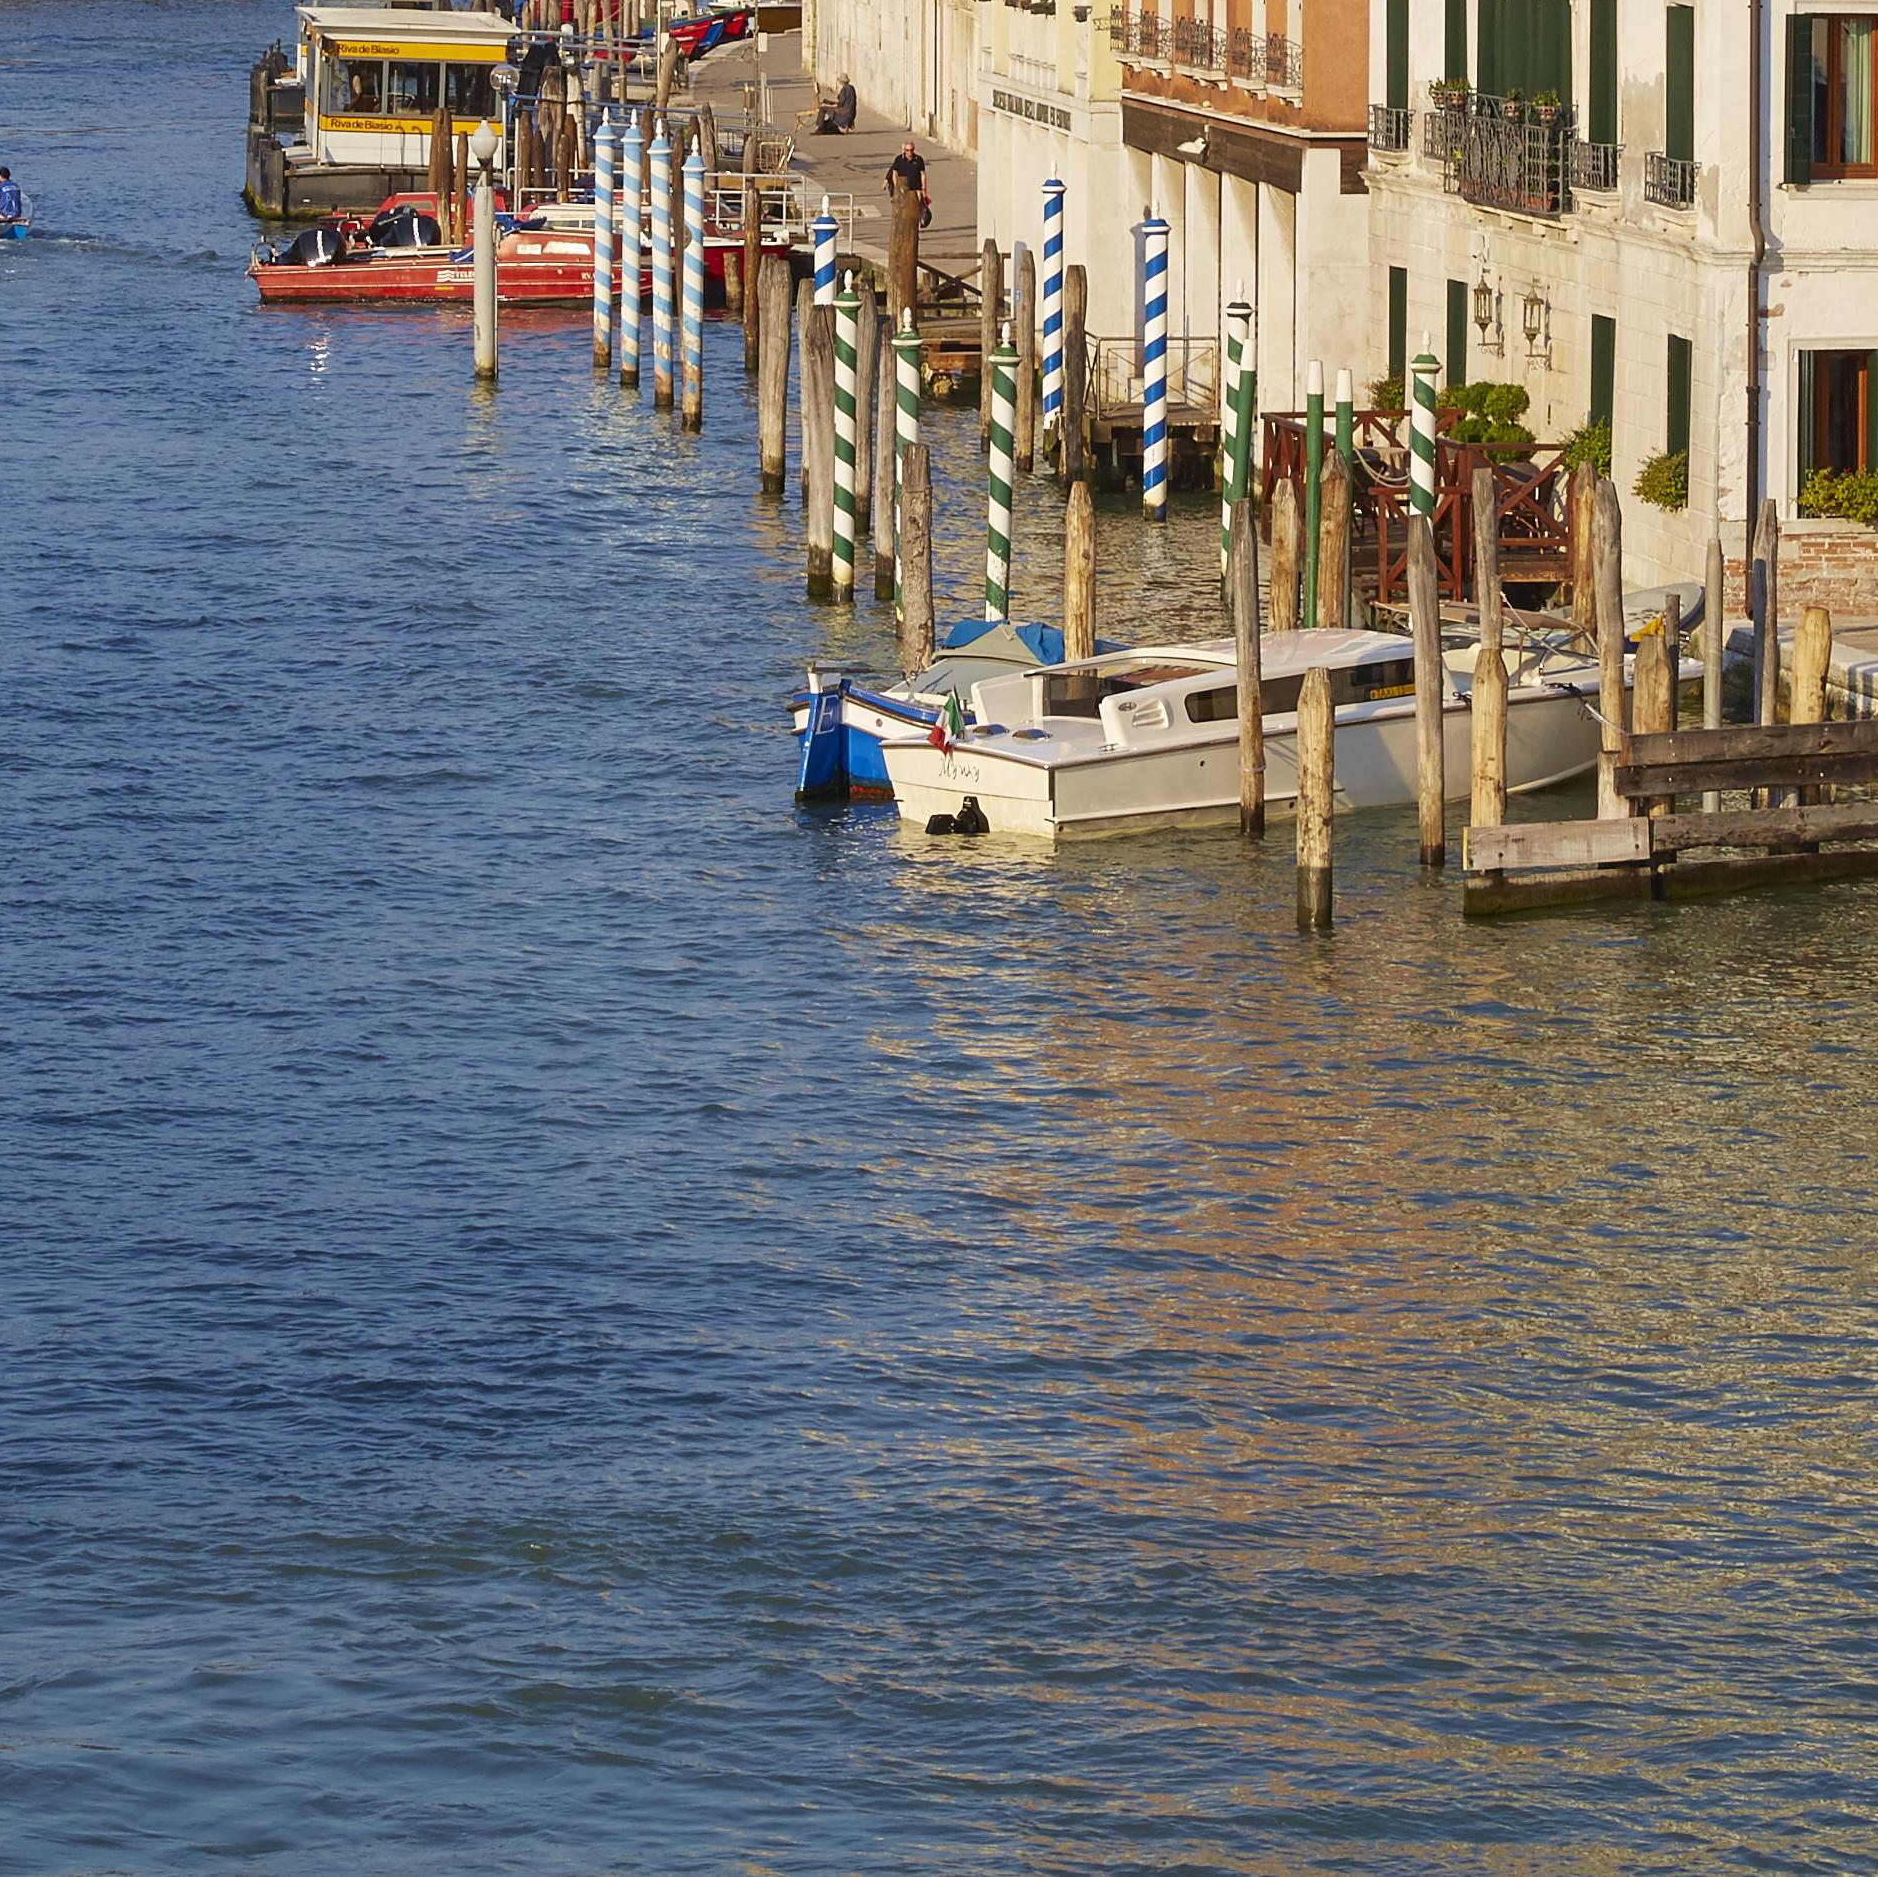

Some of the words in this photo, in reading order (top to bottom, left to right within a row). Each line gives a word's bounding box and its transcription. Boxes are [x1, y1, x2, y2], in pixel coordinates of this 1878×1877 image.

[338, 44, 357, 53] Riva
[359, 45, 370, 53] de
[371, 45, 399, 55] Biasio
[331, 119, 351, 128] Riva
[352, 120, 364, 129] de
[365, 120, 393, 130] Biasio
